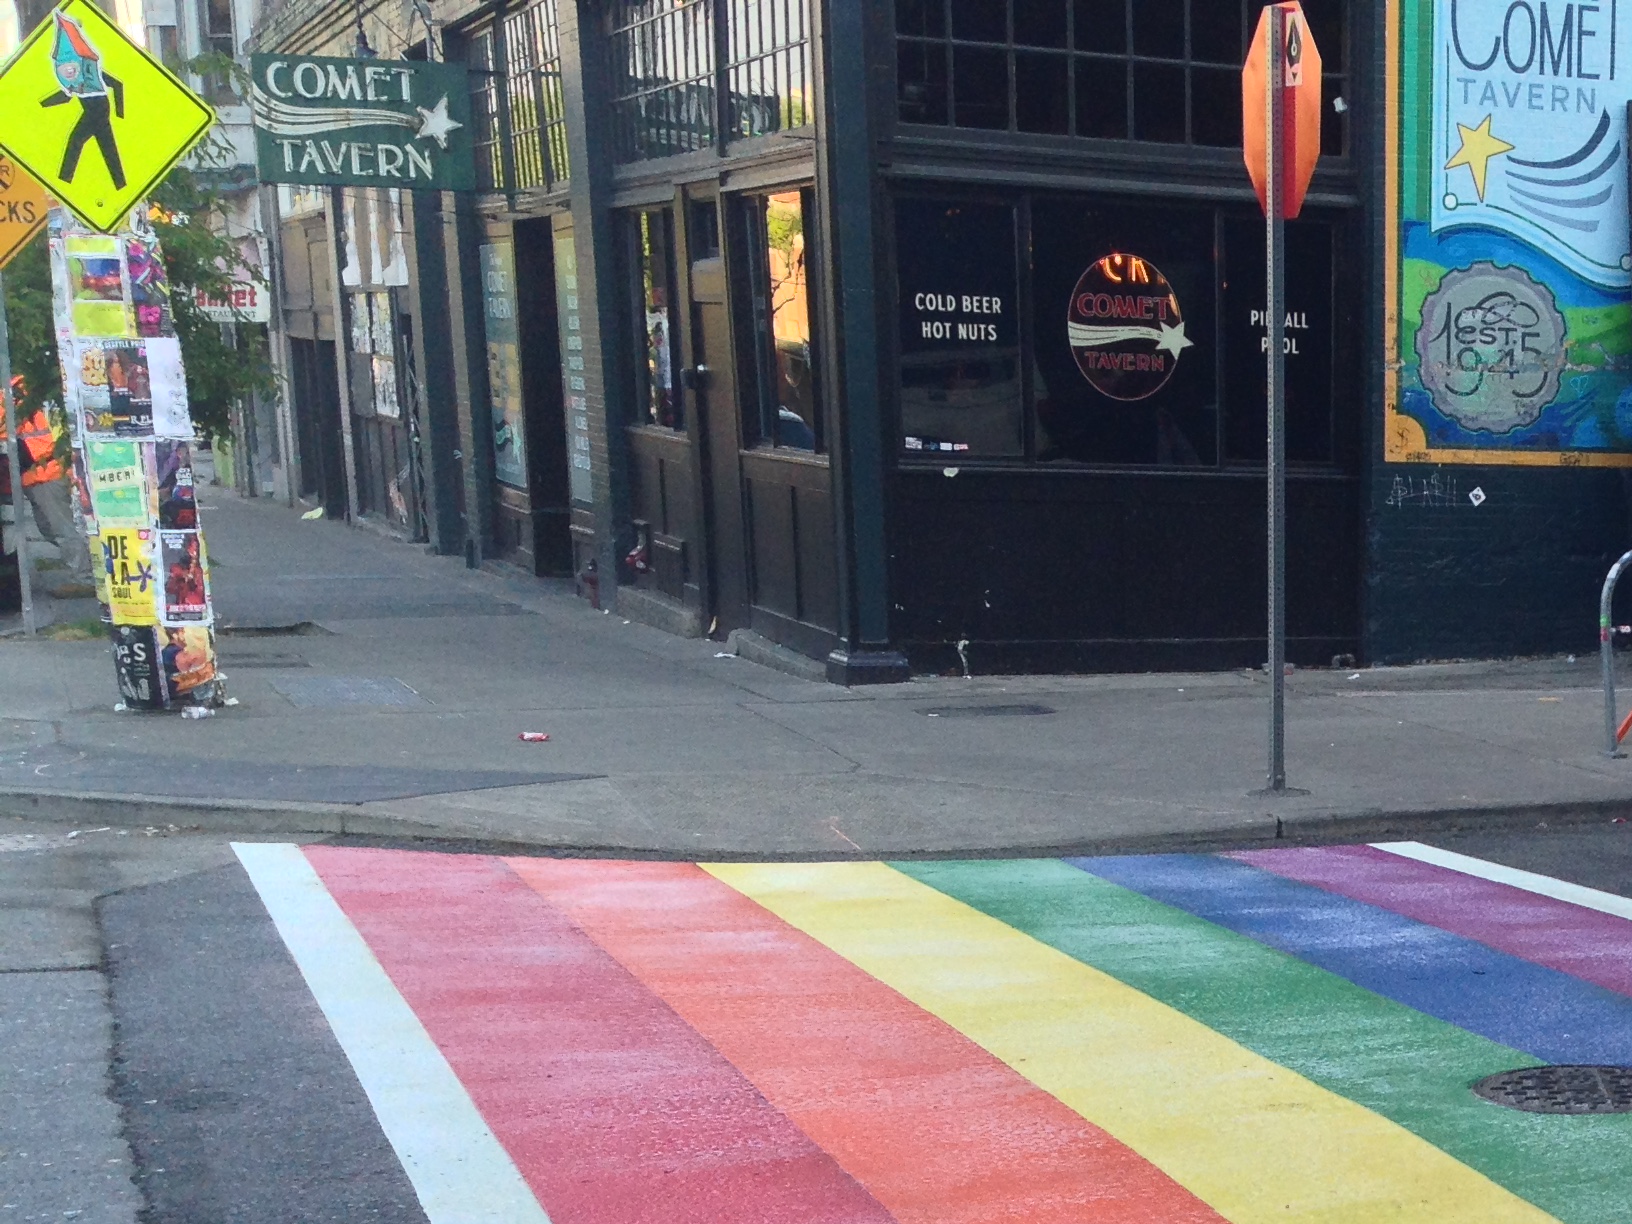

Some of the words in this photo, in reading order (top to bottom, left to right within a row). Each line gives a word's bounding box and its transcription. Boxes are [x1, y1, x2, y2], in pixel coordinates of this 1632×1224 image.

[266, 61, 418, 102] COMET
[1456, 77, 1596, 114] TAVERN
[272, 138, 433, 181] TAVERN
[915, 292, 956, 312] COLD
[962, 295, 1002, 313] BEER
[1077, 293, 1171, 321] COMET
[1250, 309, 1309, 328] PIALL
[922, 321, 952, 339] HOT
[958, 323, 997, 341] NUTS
[1261, 337, 1300, 354] POL
[1429, 302, 1548, 398] 1945
[1084, 351, 1165, 372] TAVERN
[107, 535, 129, 560] DE
[110, 561, 131, 585] LA
[112, 586, 132, 600] SOUL
